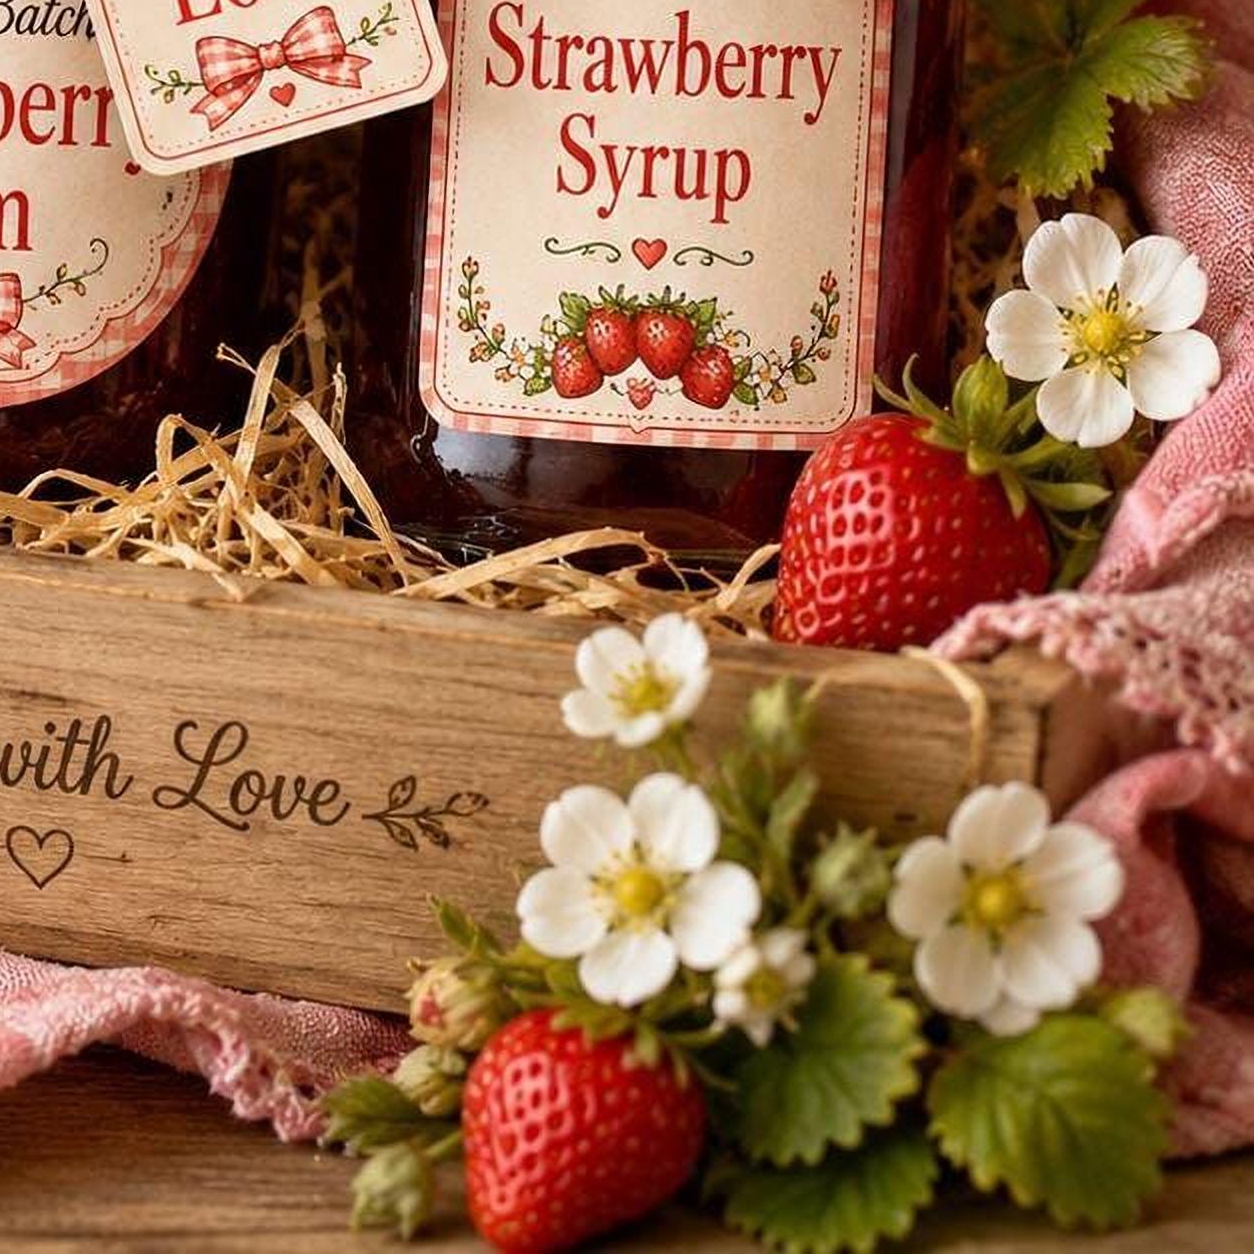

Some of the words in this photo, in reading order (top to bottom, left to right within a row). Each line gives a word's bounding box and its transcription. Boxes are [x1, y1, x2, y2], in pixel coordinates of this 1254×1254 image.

[484, 0, 842, 125] Strawberry
[555, 112, 752, 224] Syrup
[152, 719, 352, 832] Love
